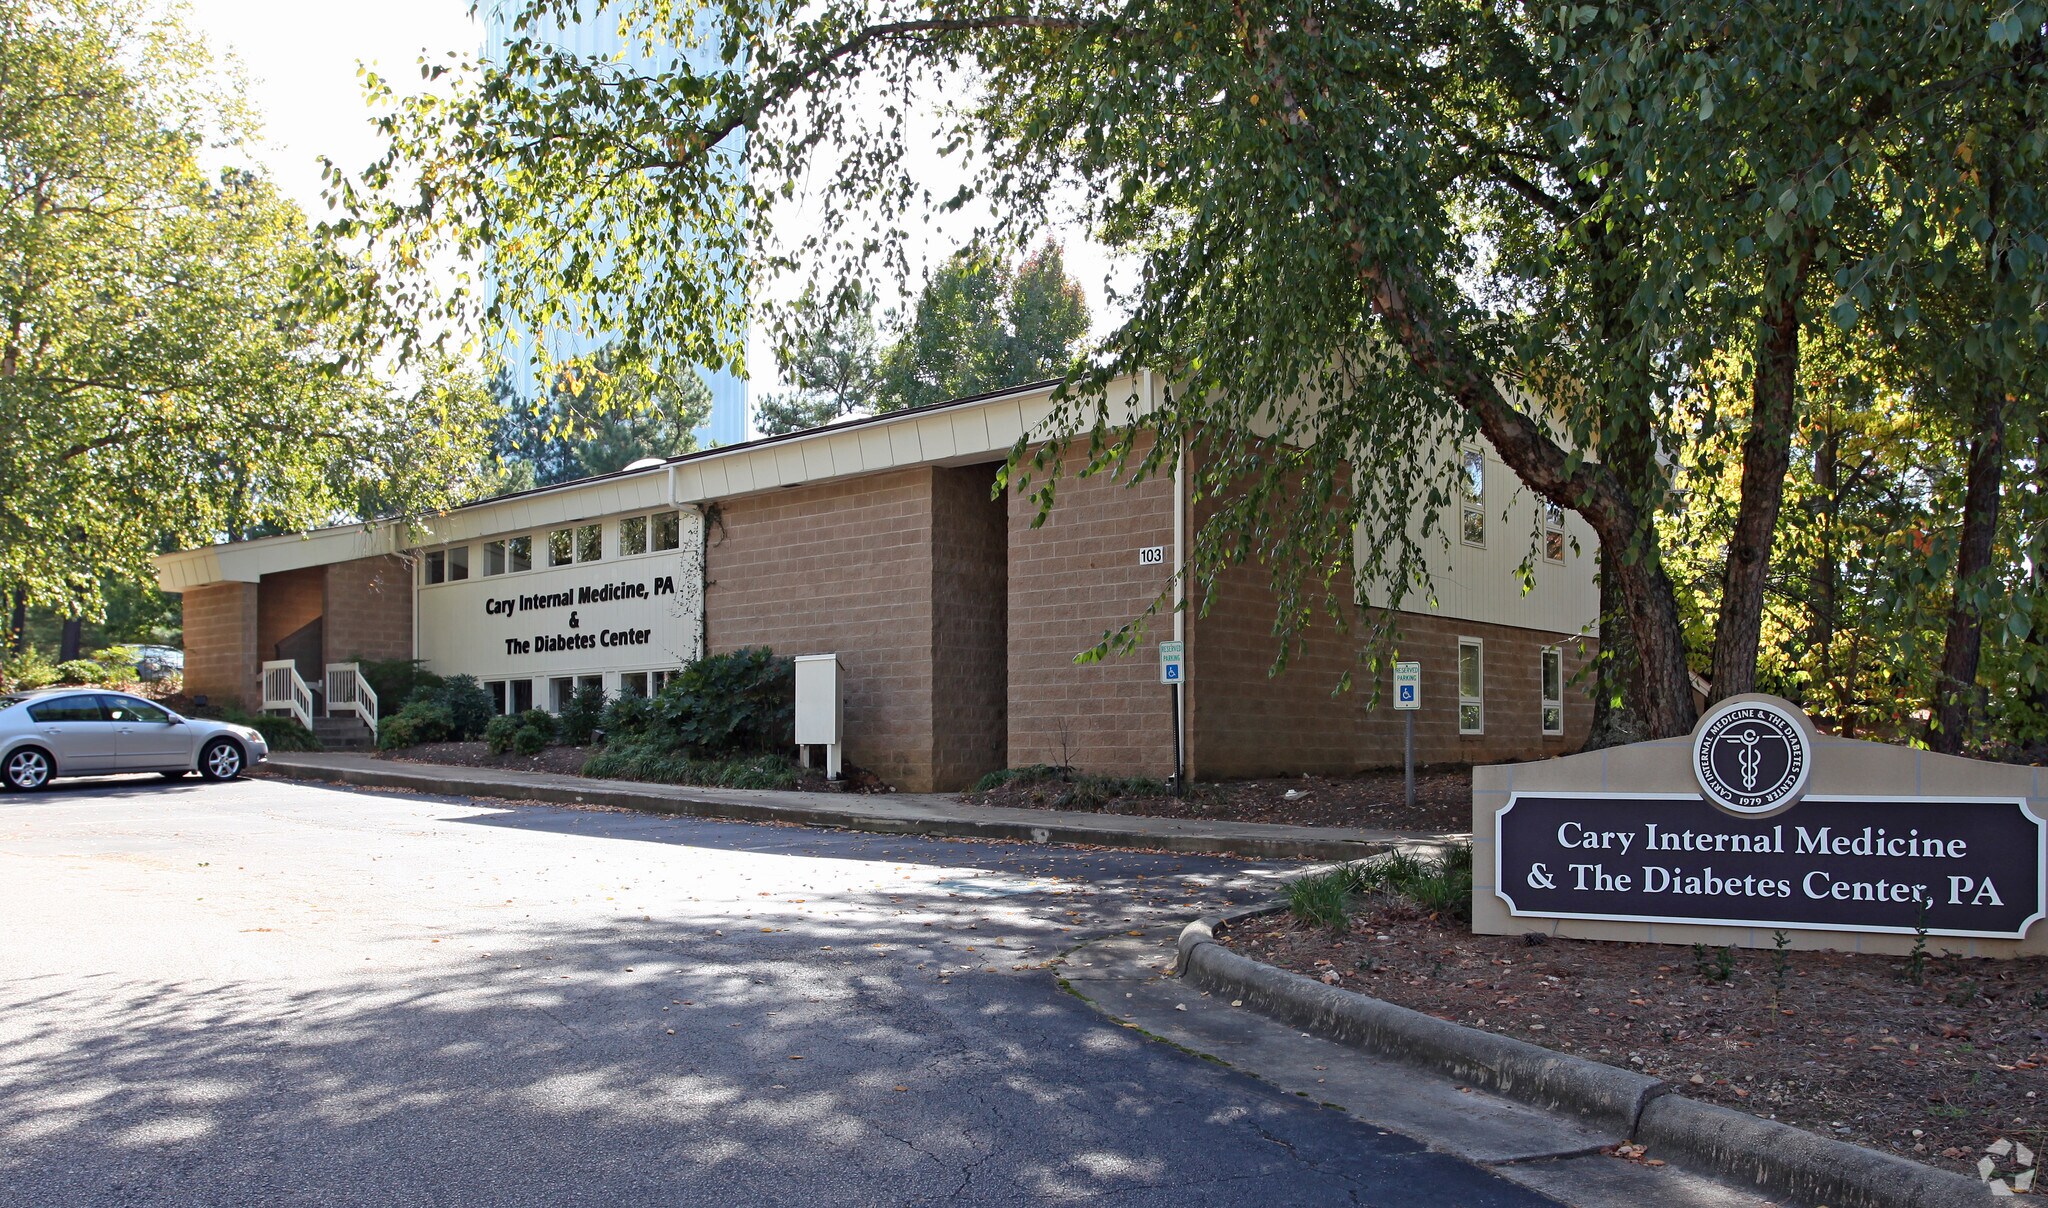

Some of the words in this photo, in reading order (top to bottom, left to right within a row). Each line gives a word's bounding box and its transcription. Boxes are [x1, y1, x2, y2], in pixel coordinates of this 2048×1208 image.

[1141, 548, 1162, 563] 103
[485, 597, 515, 617] Cary
[519, 588, 574, 611] Internal
[578, 581, 649, 604] Medicine,
[654, 575, 675, 596] PA
[568, 610, 580, 629] &
[505, 638, 530, 655] The
[534, 634, 596, 652] Diabetes
[600, 628, 651, 647] Center
[1710, 709, 1755, 736] MEDICINE
[1757, 710, 1766, 719] &
[1768, 713, 1786, 729] THE
[1700, 736, 1715, 781] INTERNAL
[1783, 728, 1802, 773] DIABETES
[1710, 781, 1733, 800] CARY
[1739, 797, 1762, 806] 1979
[1766, 774, 1796, 802] CENTER
[1557, 822, 1636, 855] Cary
[1645, 823, 1784, 854] Internal
[1795, 826, 1967, 859] Medicine
[1527, 863, 1557, 890] &
[1569, 864, 1632, 893] The
[1643, 866, 1791, 898] Diabetes
[1803, 871, 1934, 910] Center,
[1947, 875, 2004, 906] PA
